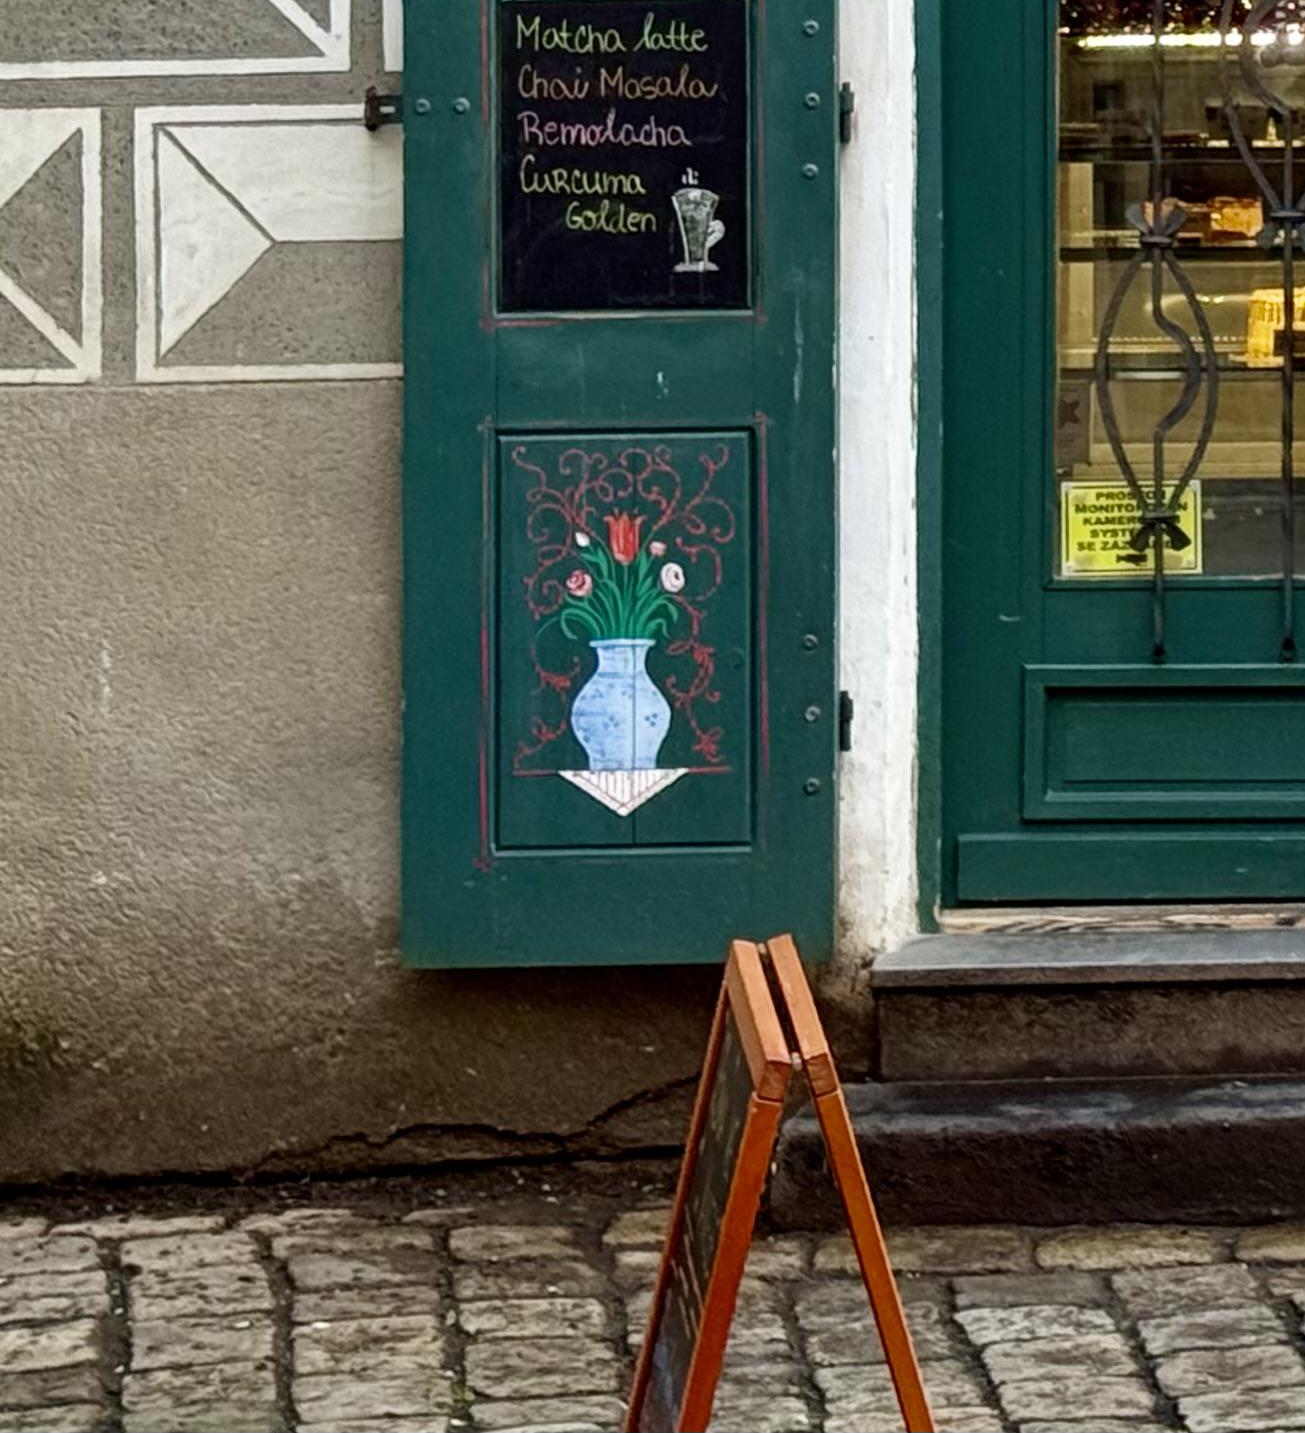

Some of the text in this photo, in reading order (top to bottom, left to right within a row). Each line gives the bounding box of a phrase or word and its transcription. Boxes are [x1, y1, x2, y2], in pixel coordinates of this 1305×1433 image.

[516, 11, 710, 53] Matcha latte
[517, 63, 590, 100] Chai
[516, 108, 693, 147] Remolacha
[564, 199, 658, 233] Golden
[1077, 541, 1096, 551] SE
